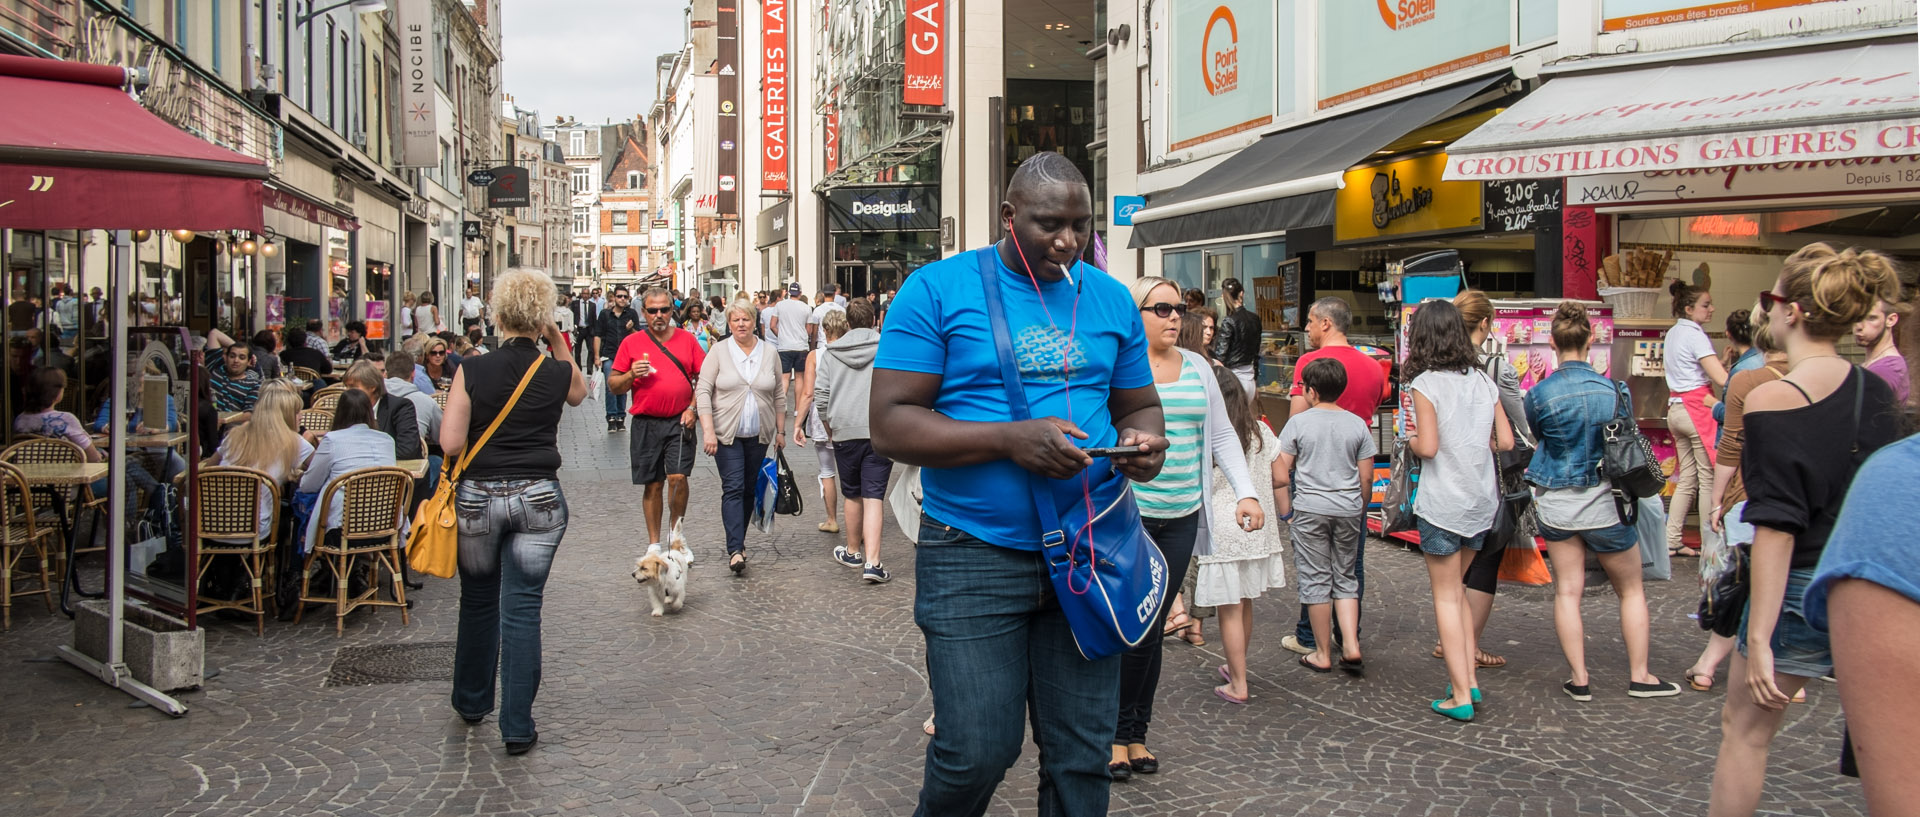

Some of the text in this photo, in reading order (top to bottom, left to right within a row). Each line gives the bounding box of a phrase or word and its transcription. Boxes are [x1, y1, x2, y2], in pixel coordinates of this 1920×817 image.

[1398, 0, 1436, 22] Soleil
[1625, 16, 1660, 28] Souriez
[1662, 14, 1684, 22] vous
[1686, 10, 1706, 19] êtes
[1710, 4, 1748, 16] bronzés
[912, 0, 938, 54] GA
[1215, 45, 1237, 71] Point
[1215, 64, 1237, 90] Soleil
[767, 48, 784, 160] GALERIES
[1680, 100, 1821, 121] Depuis
[1457, 144, 1679, 176] CROUSTILLONS
[1699, 129, 1857, 160] GAUFRES
[1846, 170, 1891, 186] Depuis
